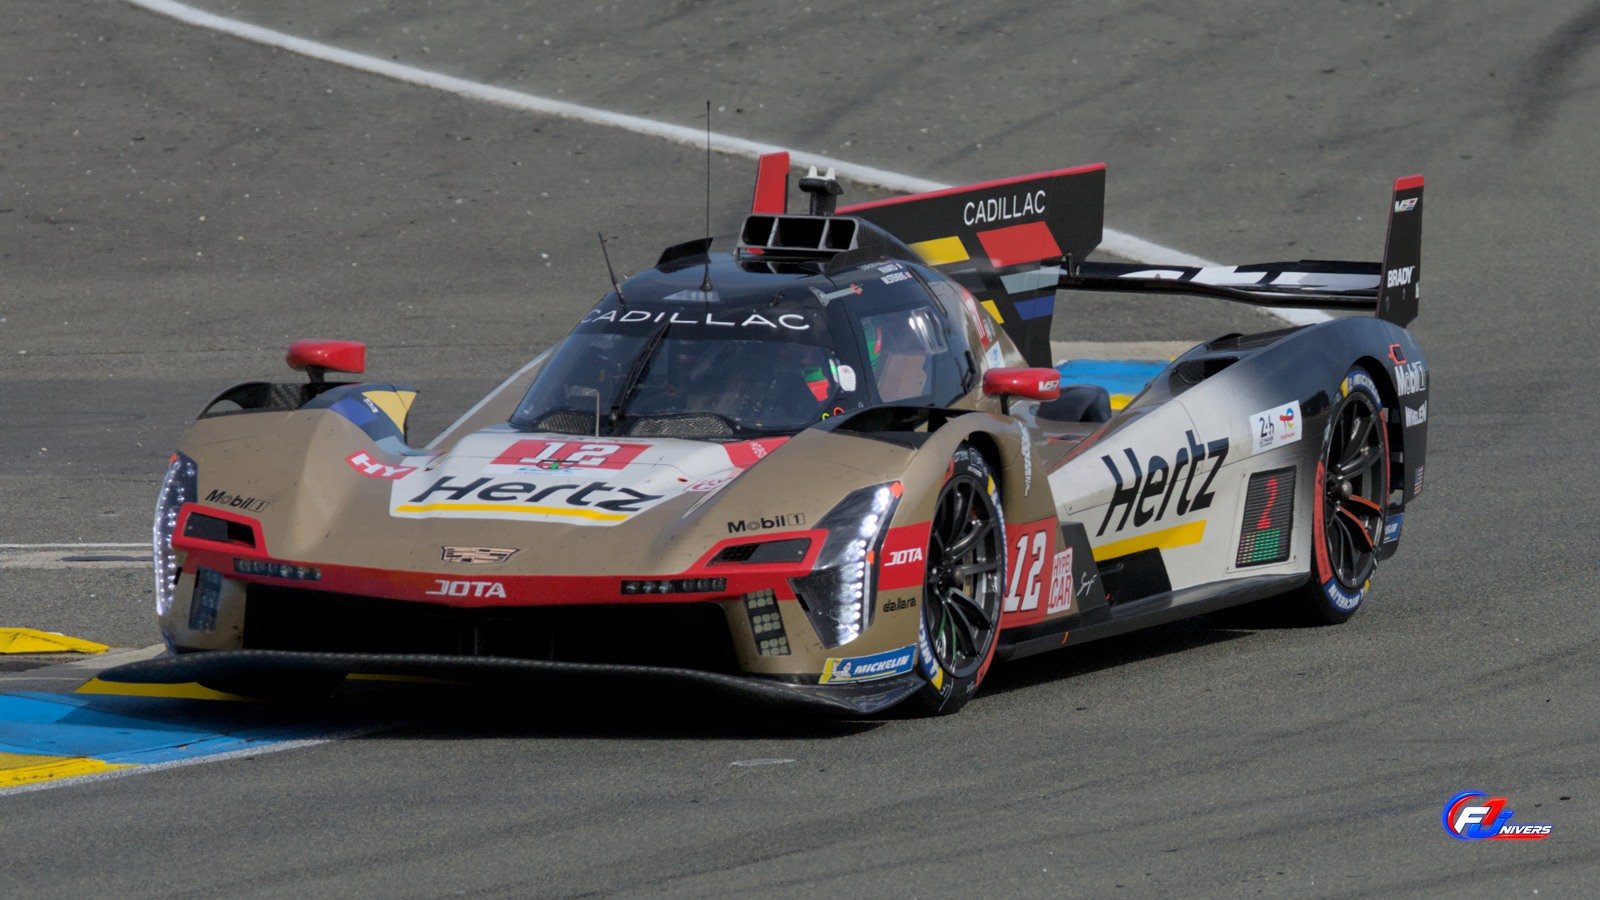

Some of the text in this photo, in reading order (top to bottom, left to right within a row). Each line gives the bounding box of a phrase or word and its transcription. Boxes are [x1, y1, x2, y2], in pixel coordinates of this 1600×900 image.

[964, 190, 1046, 226] CADILLAC
[1387, 267, 1414, 288] BRADY
[581, 309, 810, 331] CADILLAC
[518, 442, 621, 466] 12
[409, 476, 665, 512] Hertz
[1096, 430, 1229, 537] Hertz
[205, 490, 255, 509] Mobil
[727, 515, 785, 533] Mobil
[884, 547, 923, 566] JOTA
[1003, 531, 1047, 612] 12
[425, 579, 507, 598] JOTA
[1049, 574, 1073, 608] CAR
[854, 654, 910, 675] MICHELIN
